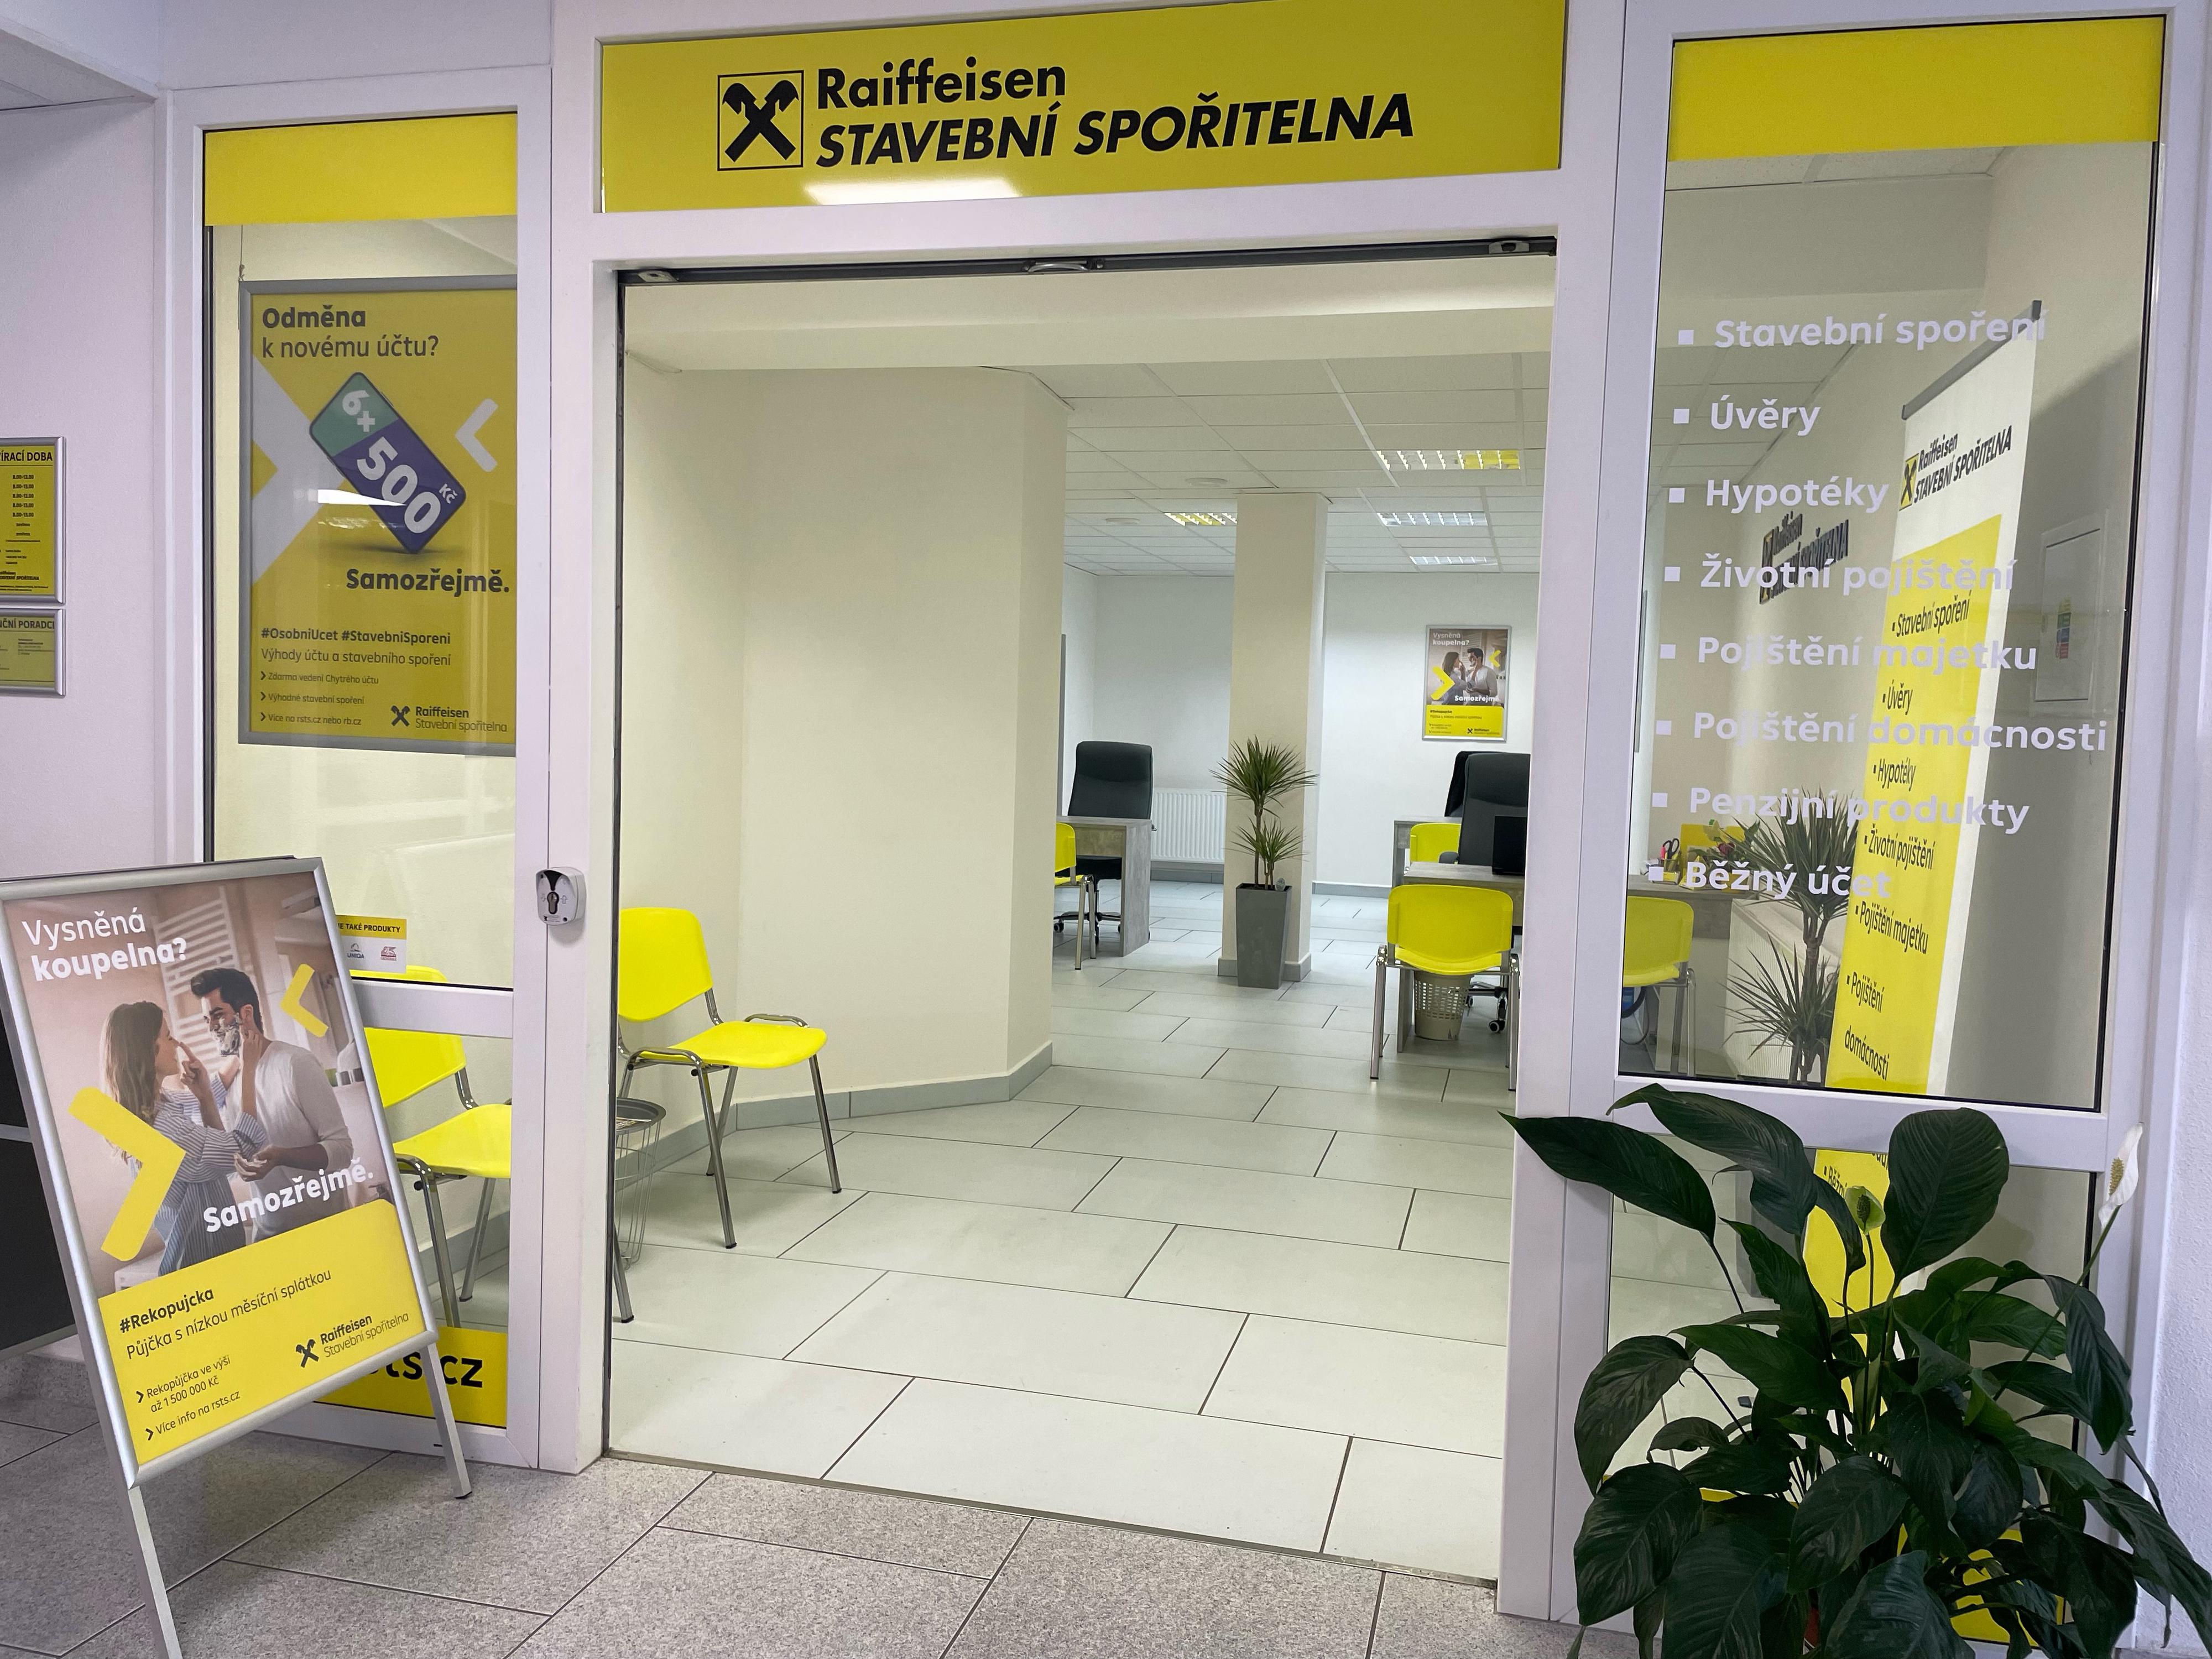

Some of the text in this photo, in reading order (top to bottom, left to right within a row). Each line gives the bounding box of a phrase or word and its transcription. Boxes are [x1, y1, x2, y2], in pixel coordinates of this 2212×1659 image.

[818, 56, 1065, 109] Raiffeisen
[816, 91, 1413, 168] STAVEBNÍ SPOŘITELNA
[263, 305, 366, 328] Odměna
[1715, 310, 2049, 351] Stavební spoření
[262, 333, 439, 358] k novému účtu?
[1710, 394, 1821, 436] Úvěry
[0, 450, 53, 461] ÍRACÍ DOBA
[1914, 425, 2012, 504] STAVEBNÍ SPOŘITELNA
[1918, 433, 1958, 472] Raiffeisen
[357, 436, 458, 534] 500 Kč
[1707, 476, 1890, 514] Hypotéky
[346, 568, 509, 597] Samozřejmě.
[1700, 553, 1835, 588] Životní
[1843, 559, 2018, 597] pojištění
[18, 620, 55, 629] PORADCI
[1896, 589, 1972, 638] Stavební spoření
[261, 628, 451, 646] #OsobniUcet #StavebniSporeni
[261, 648, 451, 667] Výhody účtu a stavebního spoření
[1698, 635, 2037, 676] Pojištění majetku
[268, 672, 379, 685] Zdarma vedení Chytrého účtu
[1887, 679, 1913, 716] Úvěry
[268, 693, 364, 706] Výhodné stavební spoření
[268, 713, 284, 722] Více
[322, 716, 342, 724] nebo
[343, 717, 362, 725] rb.cz
[415, 706, 469, 718] Raiffeisen
[415, 718, 507, 733] Stavební spořitelna
[1694, 711, 2107, 752] Pojištění domácnosti
[1877, 757, 1916, 792] Hypotéky
[1689, 787, 2030, 834] Penzijní produkty
[1868, 823, 1936, 870] Životní pojištění
[1686, 860, 1892, 900] Běžný účet
[22, 907, 146, 951] Vysněná
[346, 922, 362, 931] TAKÉ
[364, 925, 400, 933] PRODUKTY
[1859, 900, 1928, 955] Pojištění majetku
[31, 937, 187, 982] koupelna?
[1851, 972, 1885, 1013] Pojištění
[1844, 1025, 1890, 1081] domácnosti
[203, 1157, 374, 1233] Samozřejmě.
[119, 1288, 215, 1333] #Rekopujcka
[127, 1270, 332, 1359] Půjčka s nízkou měsíční splátkou
[320, 1315, 373, 1345] Raiffeisen
[324, 1312, 409, 1358] Stavební spořitelna
[147, 1355, 231, 1399] Rekopůjčka ve výši
[151, 1400, 163, 1413] až
[170, 1389, 187, 1404] 500
[189, 1381, 206, 1396] 000
[208, 1375, 220, 1388] Kč
[155, 1391, 241, 1435] Více info na rsts.cz
